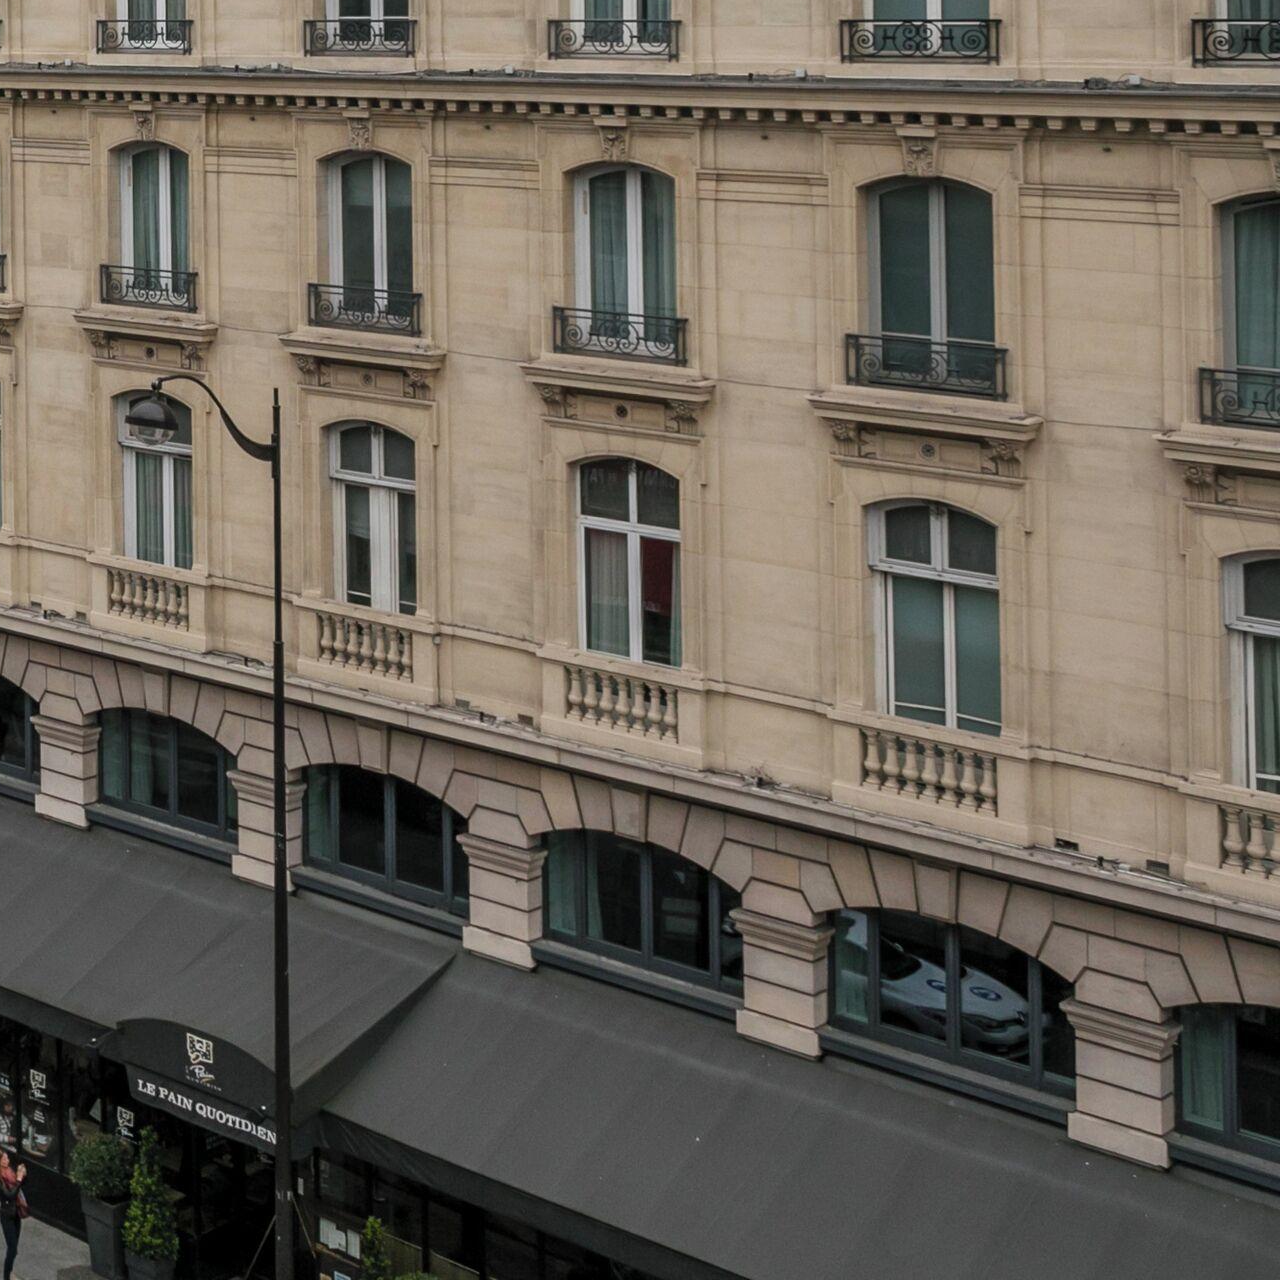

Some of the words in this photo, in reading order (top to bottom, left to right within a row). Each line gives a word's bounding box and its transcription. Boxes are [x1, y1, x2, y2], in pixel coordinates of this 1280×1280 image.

[136, 1078, 156, 1097] LE
[158, 1086, 193, 1112] PAIN
[195, 1102, 277, 1145] QUOTIDIEN
